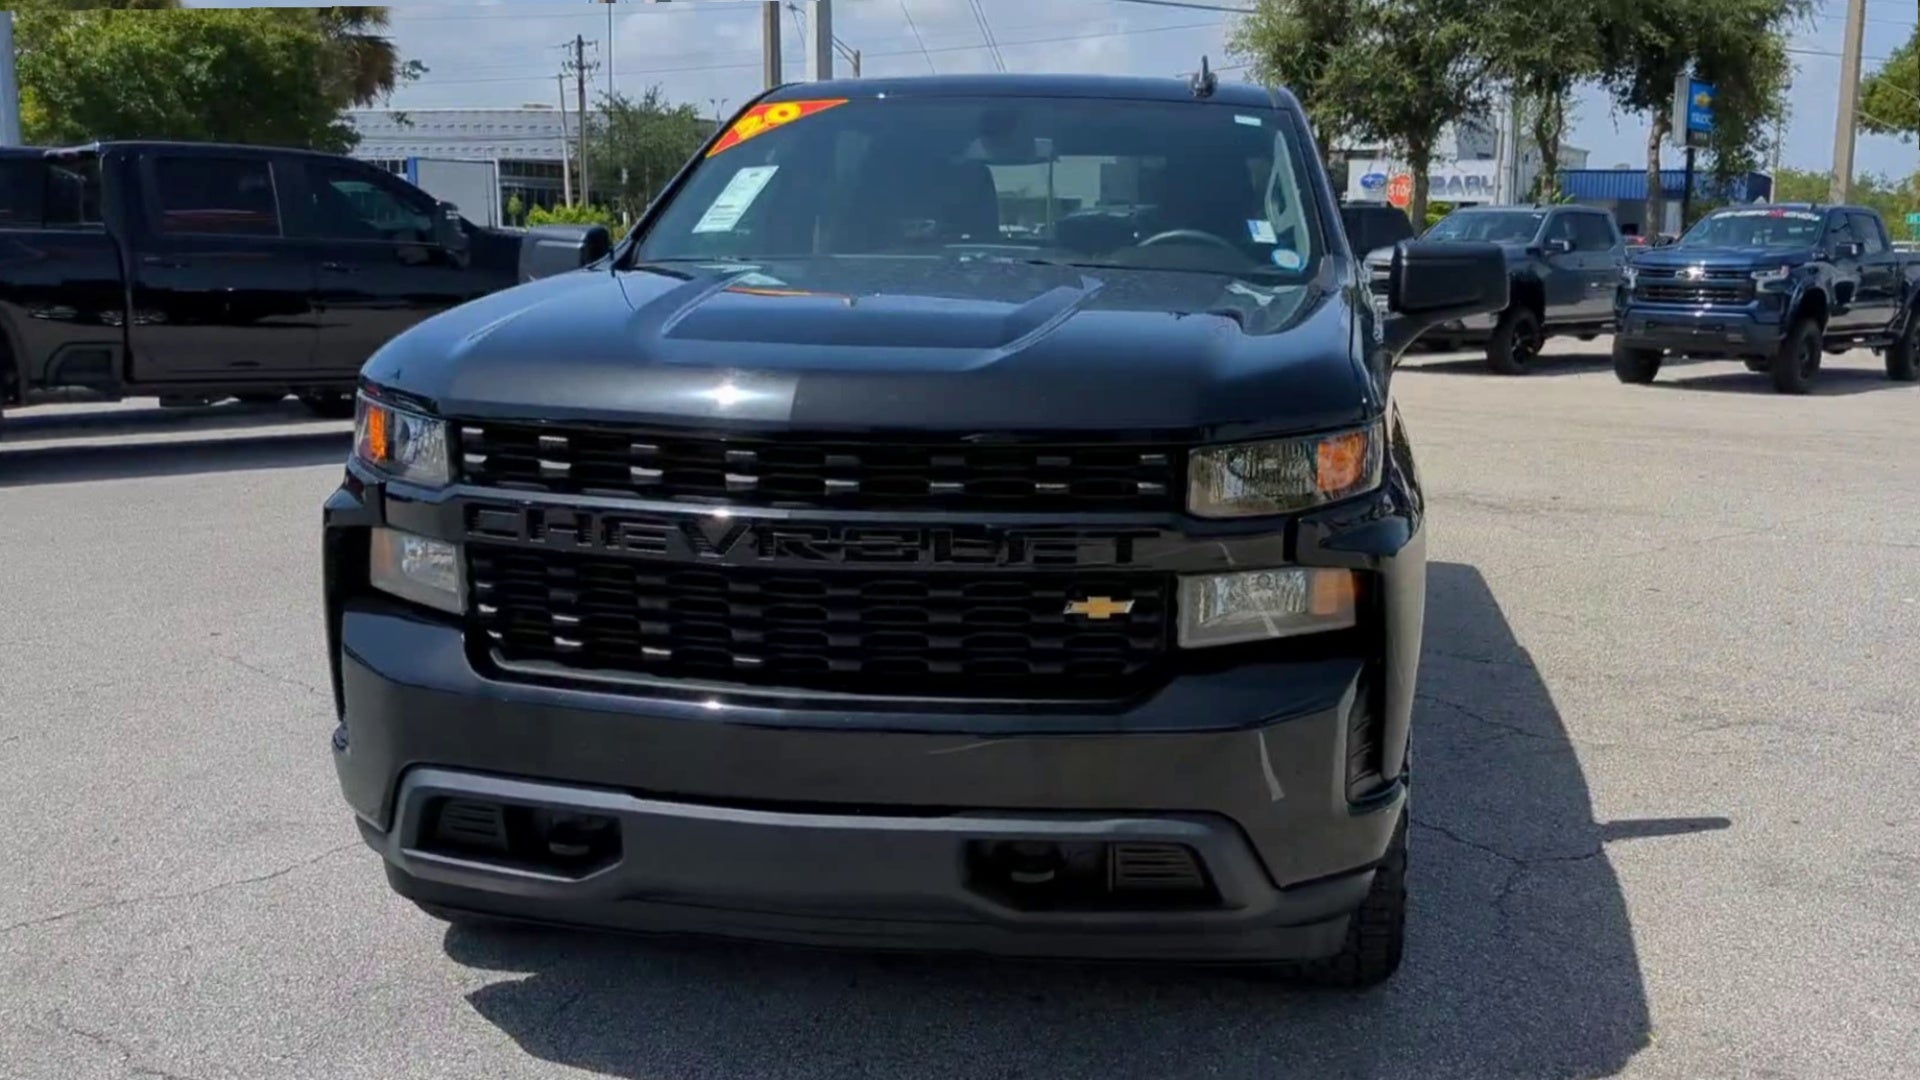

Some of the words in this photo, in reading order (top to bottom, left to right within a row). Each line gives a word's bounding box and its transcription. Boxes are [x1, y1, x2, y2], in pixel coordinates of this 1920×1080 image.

[734, 103, 801, 141] 20
[1389, 183, 1412, 197] STOP
[1430, 175, 1496, 197] BARU
[465, 503, 1161, 566] CHEVROLET
